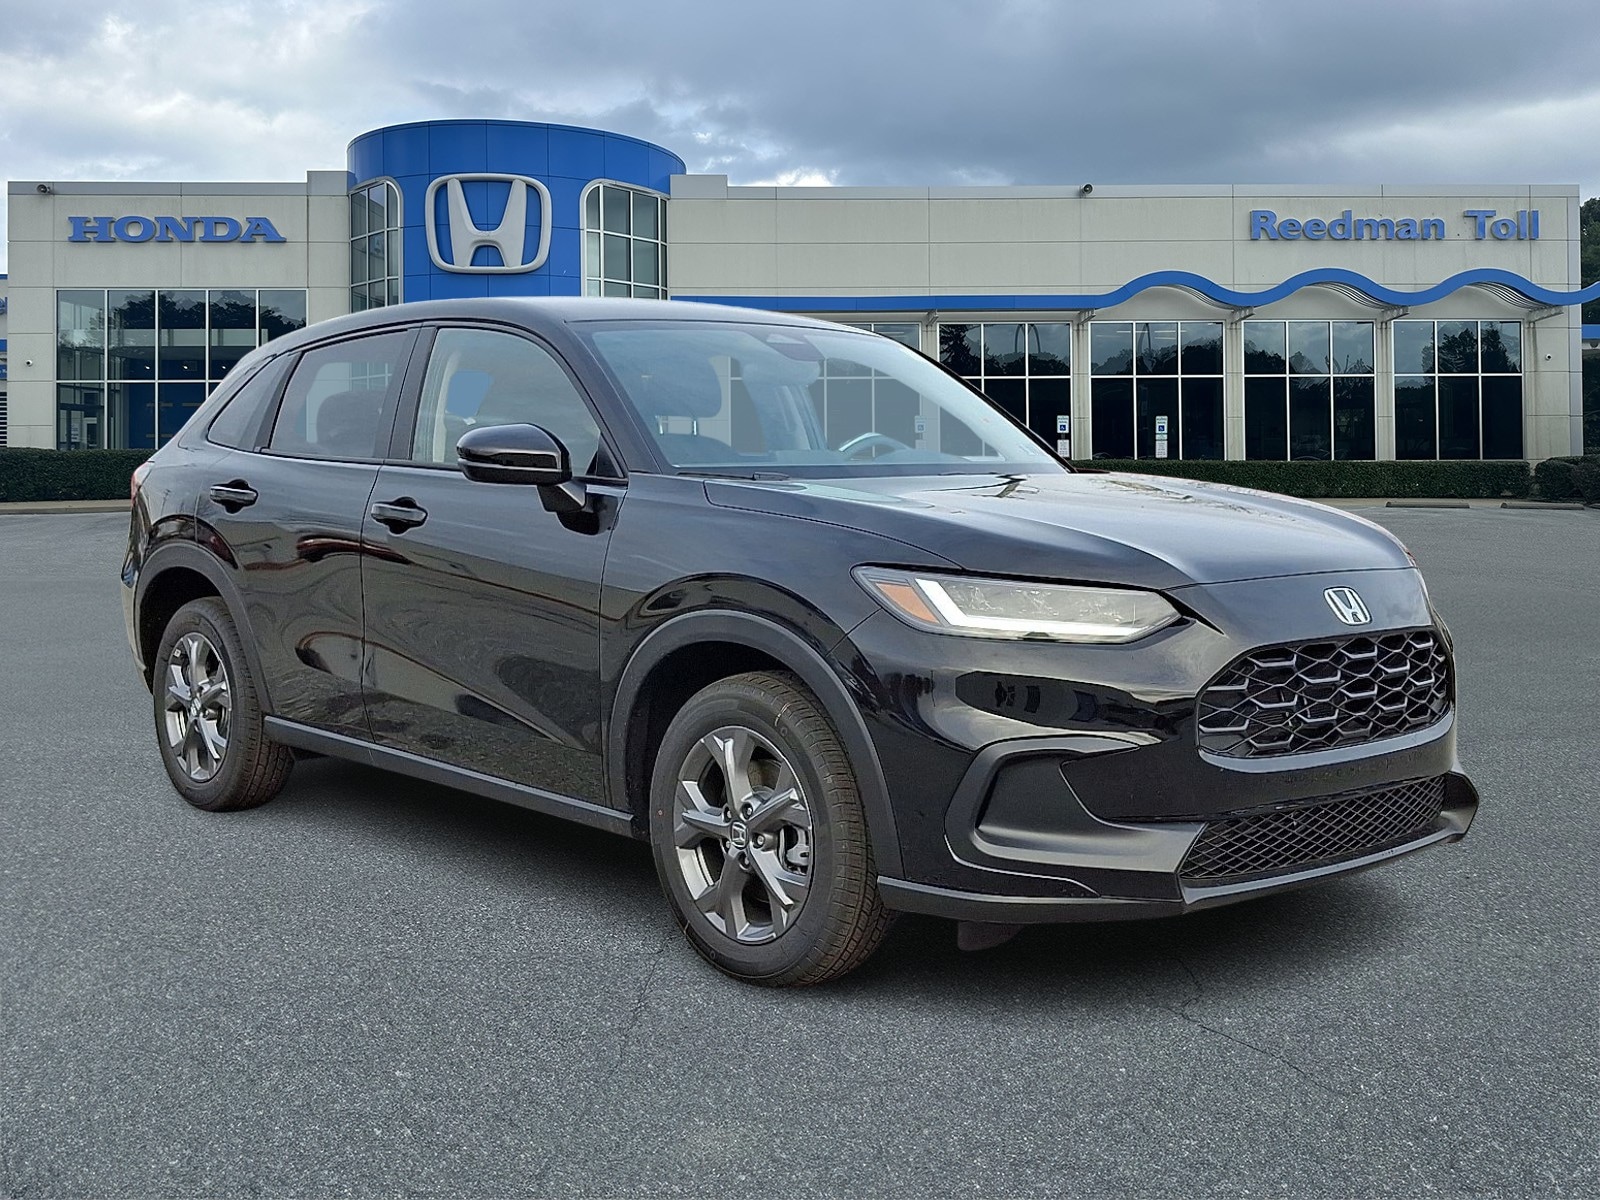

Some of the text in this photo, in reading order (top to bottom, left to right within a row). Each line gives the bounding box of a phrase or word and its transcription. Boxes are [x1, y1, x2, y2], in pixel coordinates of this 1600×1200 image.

[67, 215, 287, 243] HONDA
[1250, 209, 1540, 241] Reedman Toll
